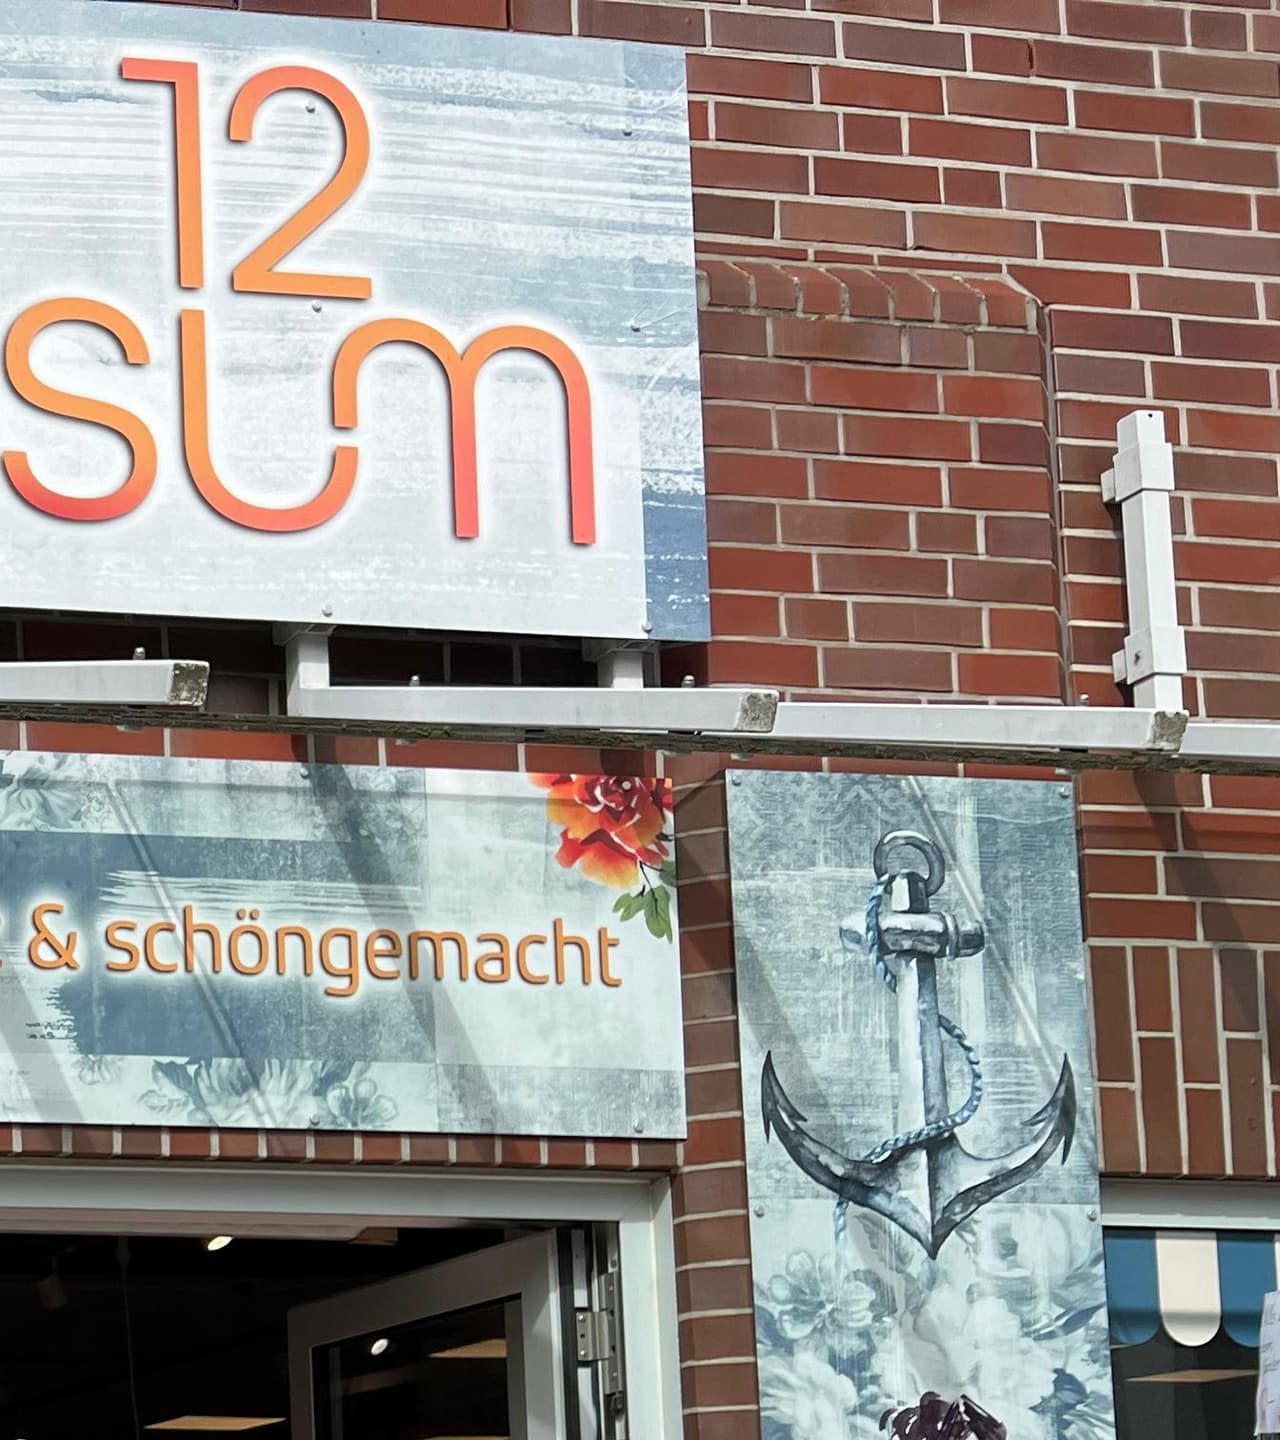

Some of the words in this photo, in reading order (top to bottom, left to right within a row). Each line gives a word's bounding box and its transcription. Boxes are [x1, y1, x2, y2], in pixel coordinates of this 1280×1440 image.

[119, 57, 373, 300] 12
[28, 903, 80, 970] &
[104, 905, 623, 997] schöngemacht
